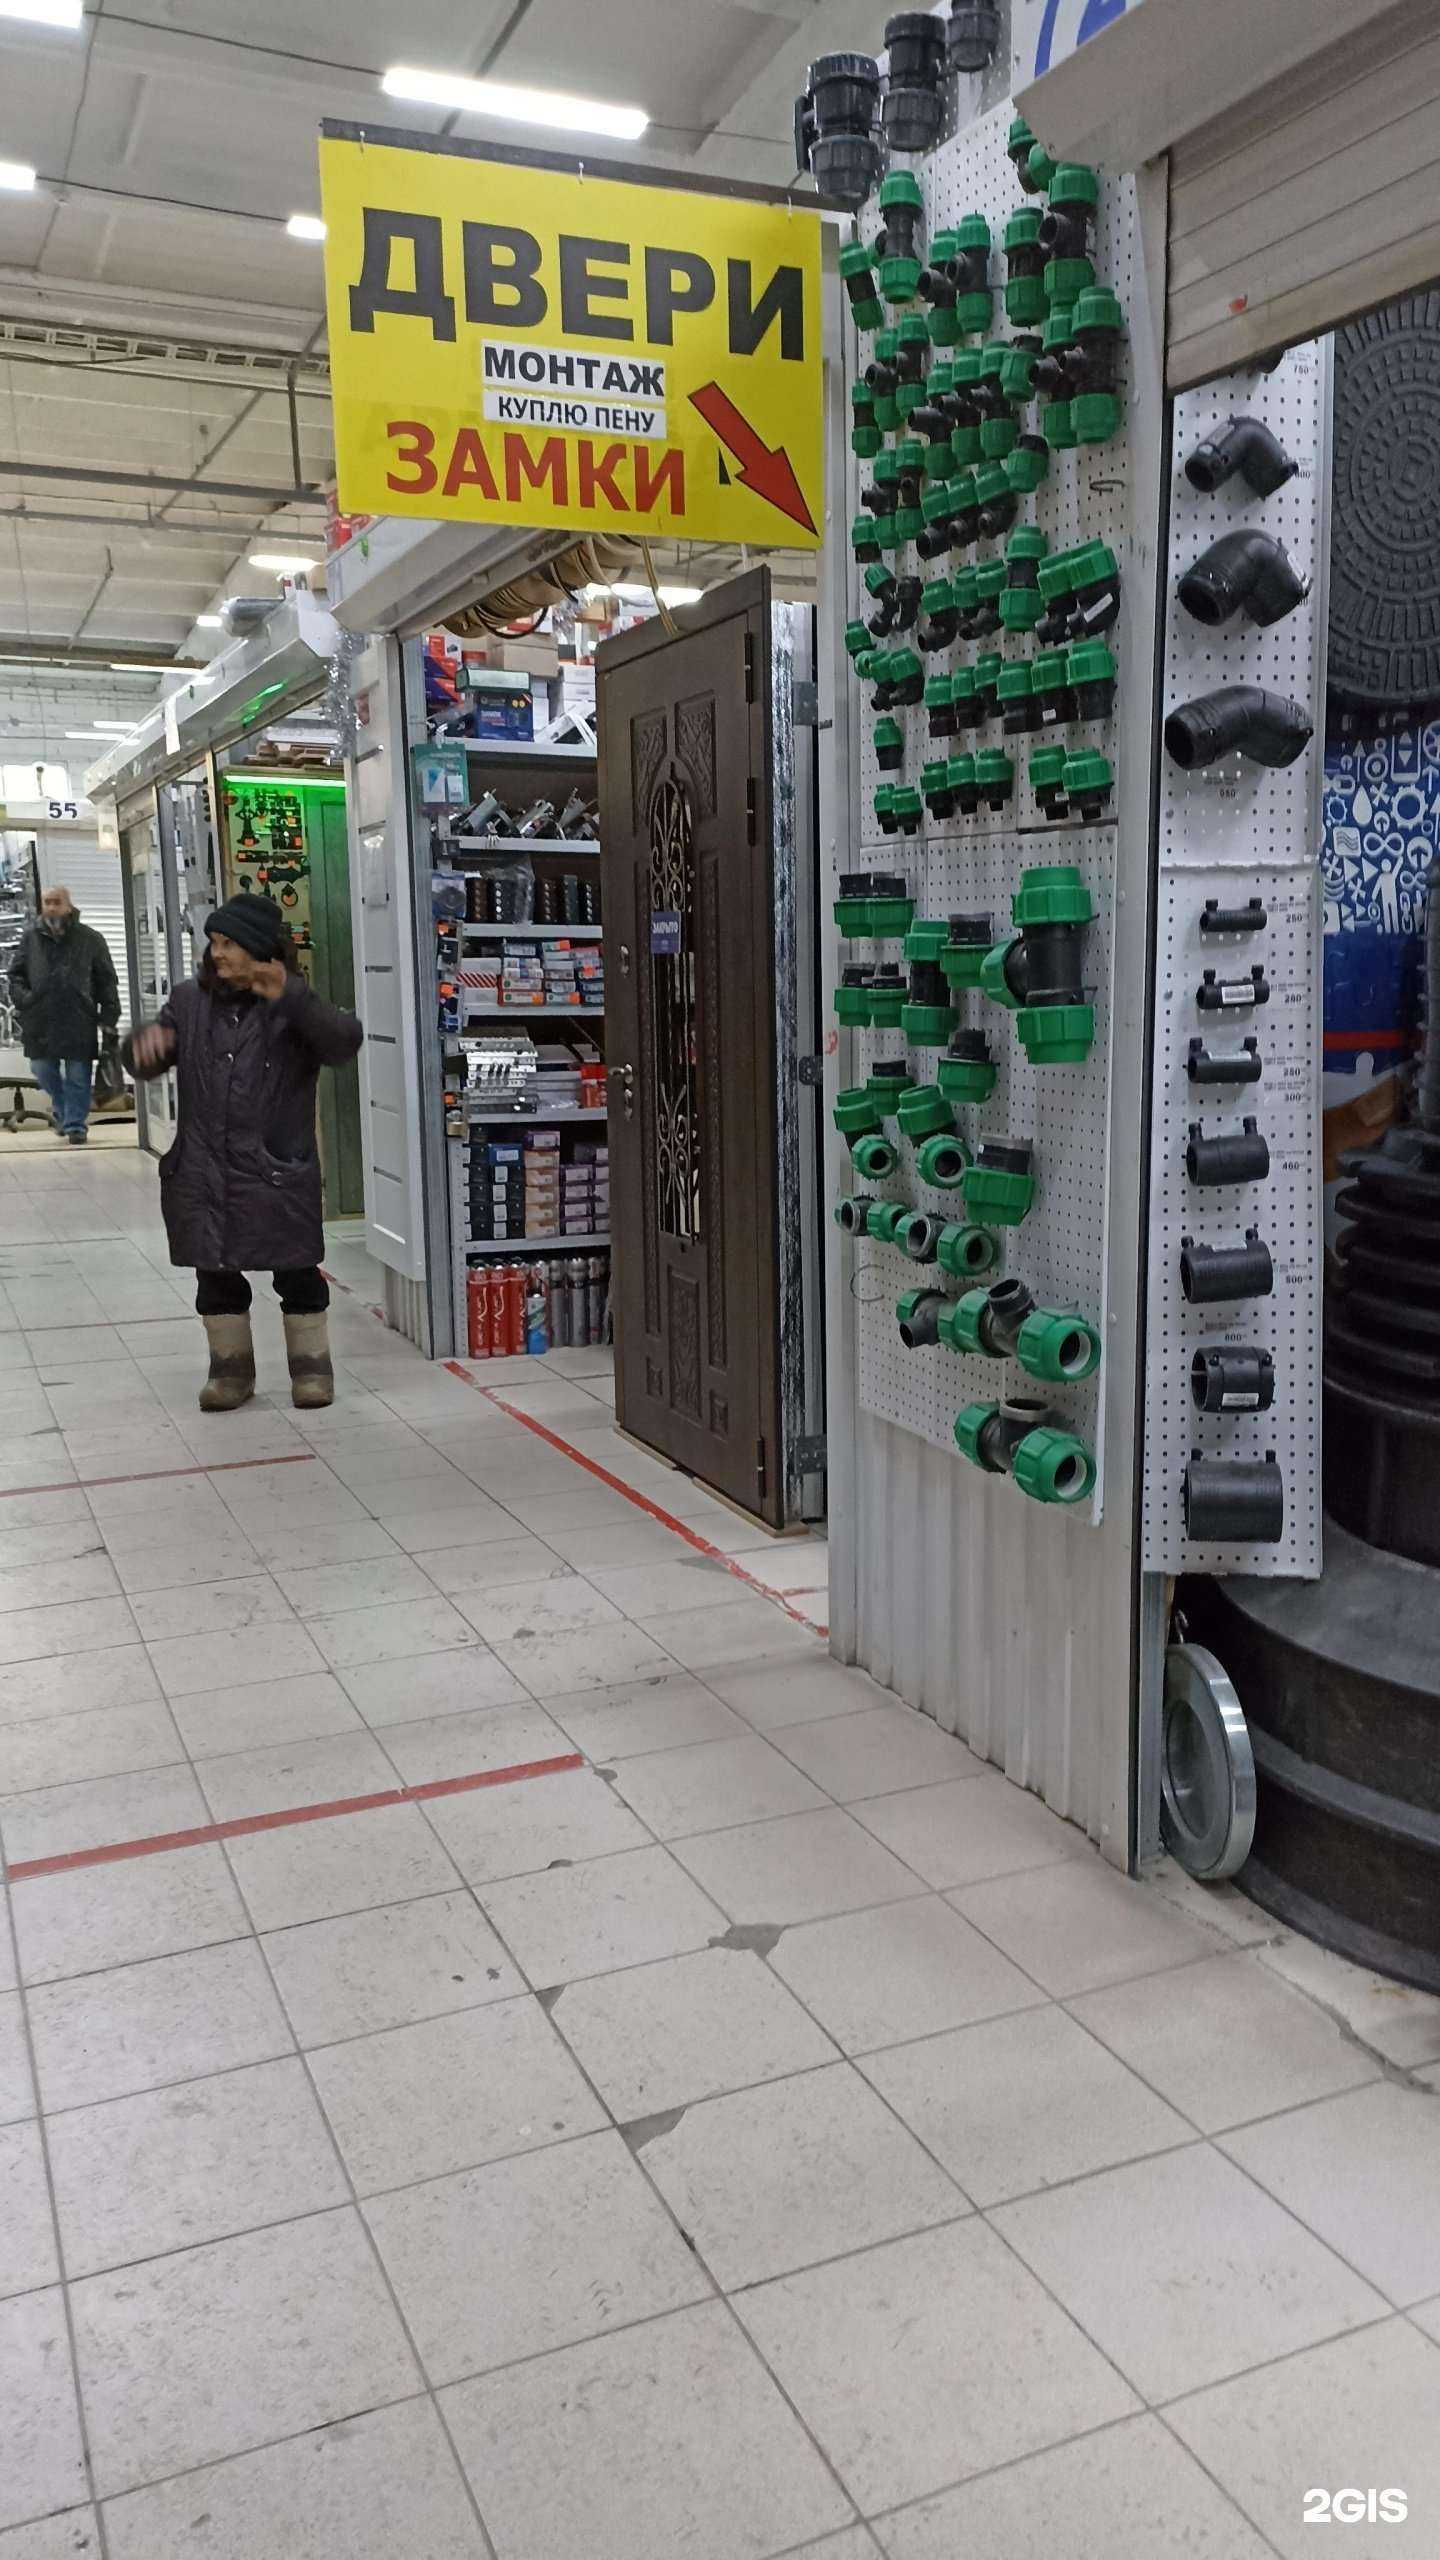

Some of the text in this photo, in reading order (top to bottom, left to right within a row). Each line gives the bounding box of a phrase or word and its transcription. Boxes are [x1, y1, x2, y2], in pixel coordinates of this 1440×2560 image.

[348, 207, 804, 361] ДВЕРИ
[484, 346, 665, 396] МОНТАЖ
[498, 396, 656, 433] КУПЛЮ ПЕНУ
[386, 420, 686, 516] ЗАМКИ
[49, 802, 78, 819] 55
